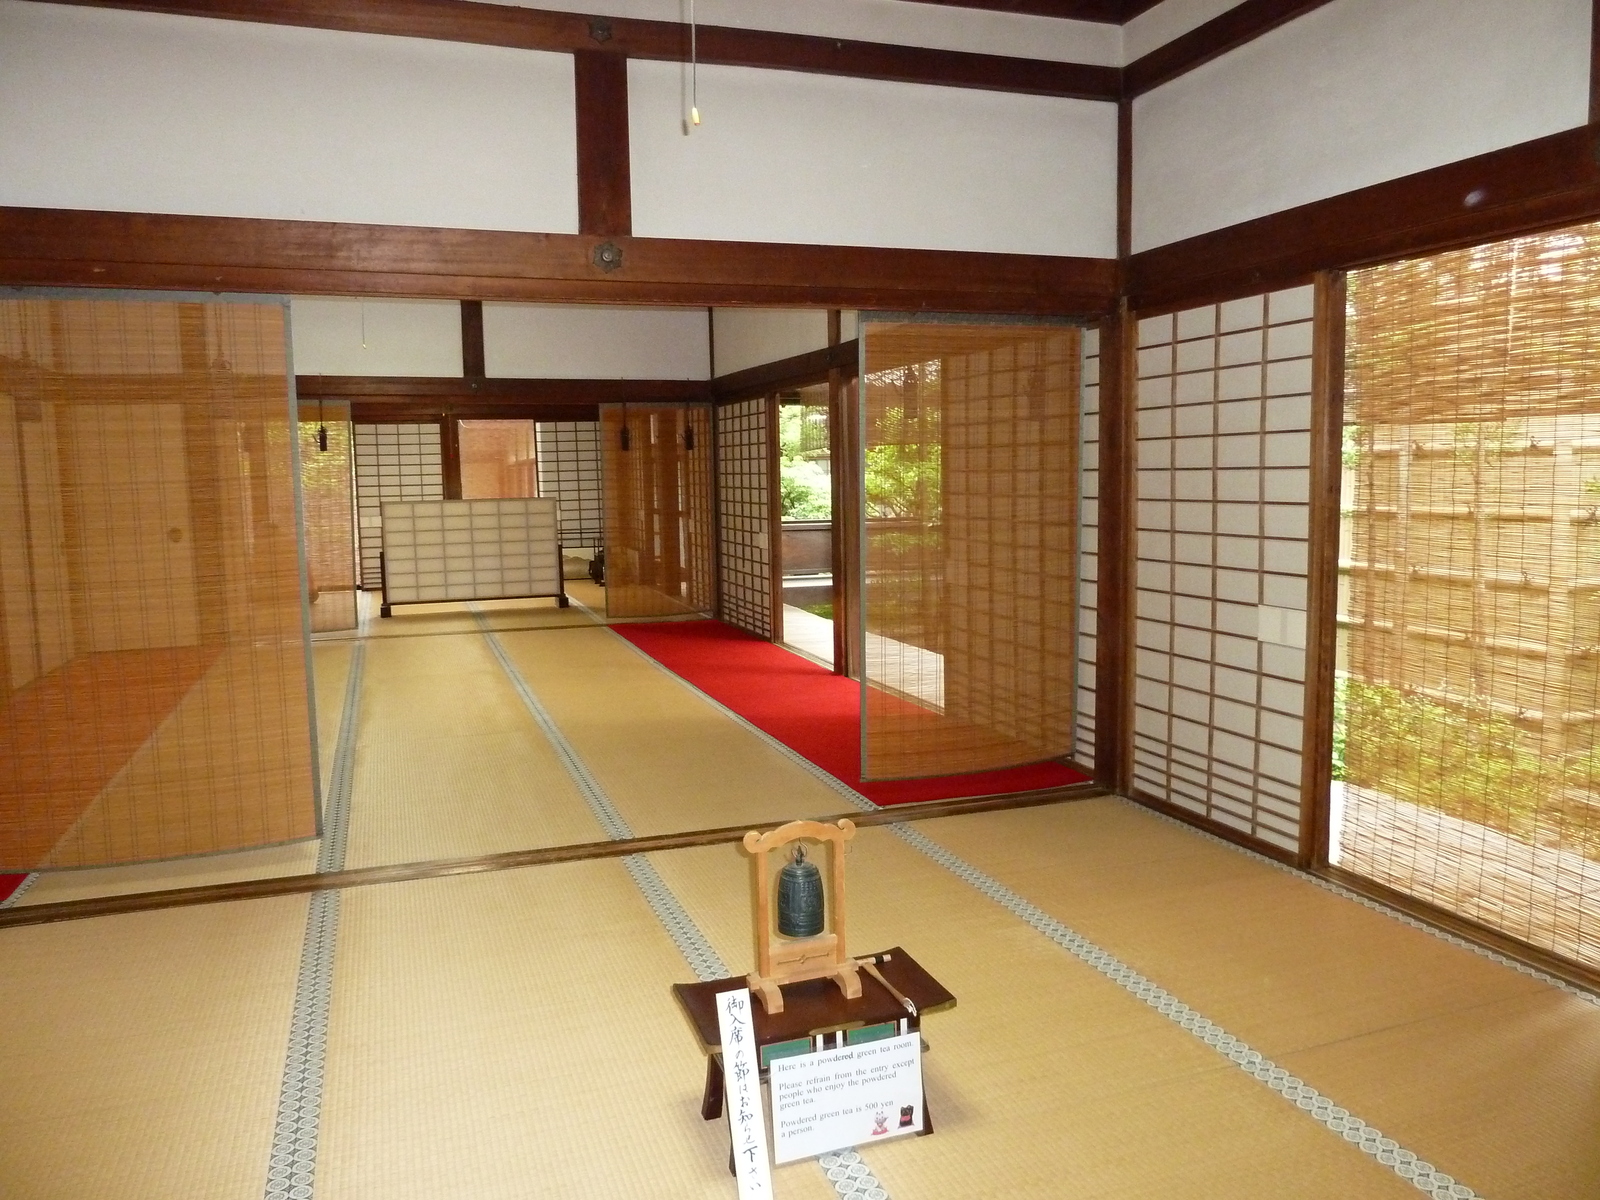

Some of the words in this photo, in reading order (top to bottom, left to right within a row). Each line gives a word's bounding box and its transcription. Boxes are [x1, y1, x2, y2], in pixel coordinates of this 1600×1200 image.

[778, 1064, 796, 1072] Here
[818, 1052, 853, 1066] powdered
[857, 1049, 877, 1058] green
[894, 1042, 913, 1050] room.
[779, 1081, 802, 1090] Please
[806, 1076, 830, 1085] refrain
[871, 1064, 888, 1074] entry
[892, 1059, 914, 1069] except
[779, 1090, 804, 1101] people
[807, 1086, 823, 1094] who
[825, 1081, 845, 1094] enjoy
[862, 1072, 897, 1086] powdered
[780, 1099, 800, 1111] green
[781, 1114, 817, 1128] Powdered
[820, 1110, 839, 1121] green
[865, 1101, 878, 1111] 500
[881, 1100, 893, 1110] yen
[789, 1125, 814, 1137] person.
